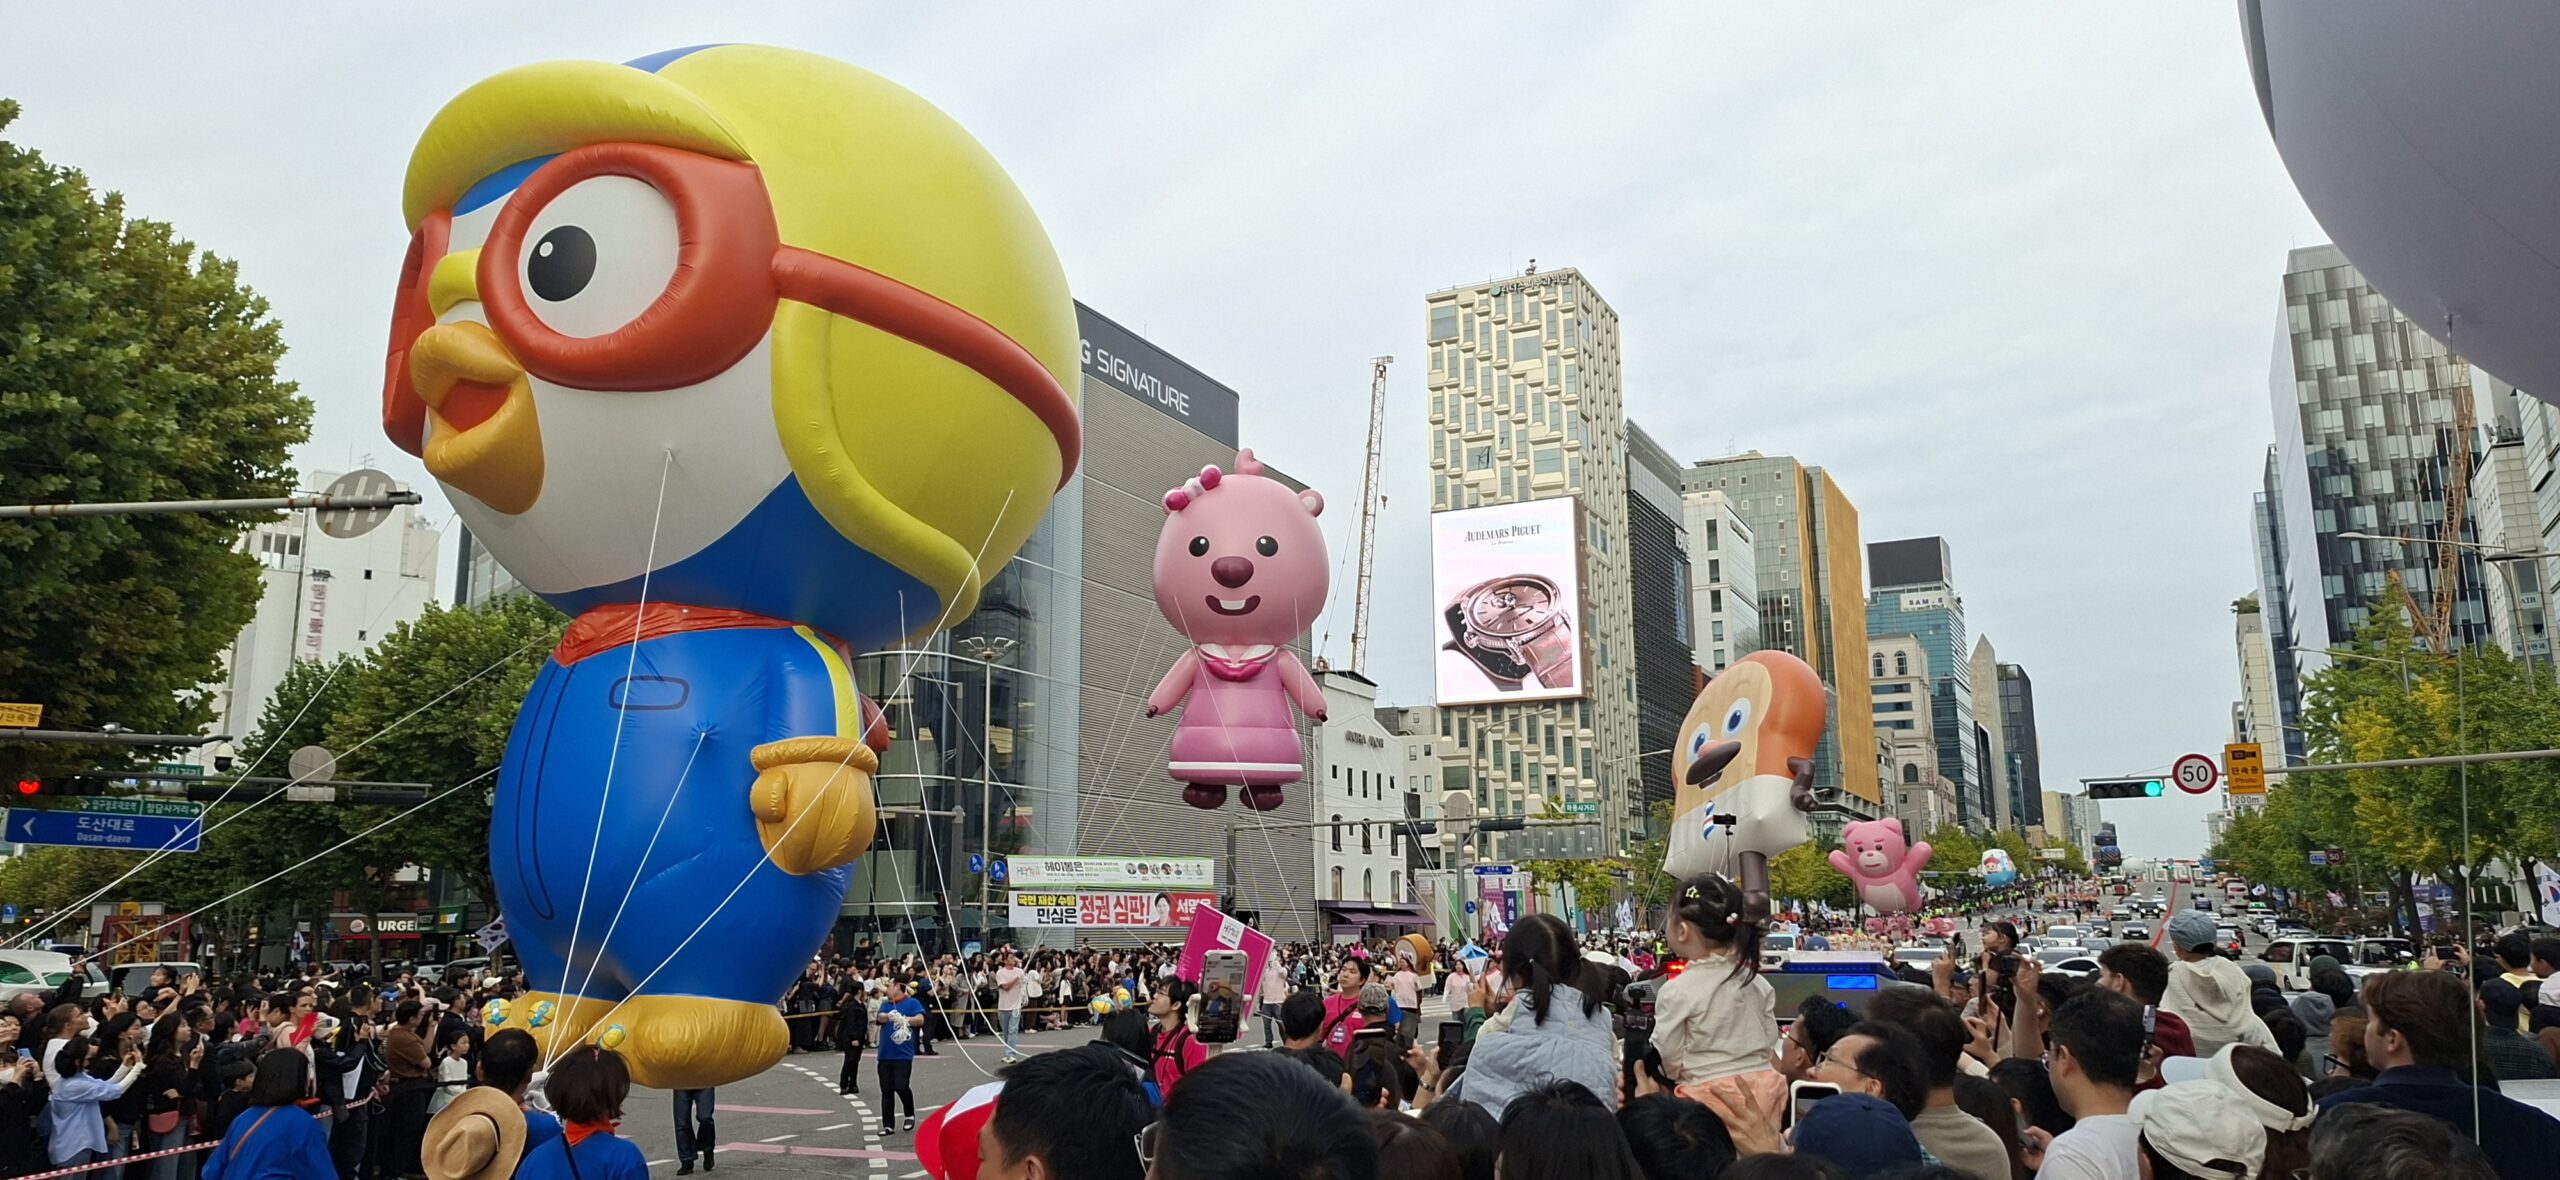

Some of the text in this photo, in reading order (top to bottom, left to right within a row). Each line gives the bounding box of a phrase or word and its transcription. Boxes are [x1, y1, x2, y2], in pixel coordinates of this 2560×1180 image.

[1080, 338, 1190, 417] G SIGNATURE
[1464, 524, 1541, 543] AUDEMARS PIGUET
[2521, 596, 2537, 604] AIR
[2182, 765, 2208, 782] 50
[2235, 796, 2259, 804] 200m
[146, 803, 189, 814] 청담사거리
[76, 816, 135, 832] 도산대로
[76, 832, 132, 844] Dosan-daero
[2329, 852, 2340, 861] 50
[1018, 895, 1036, 906] 국민
[1038, 895, 1056, 906] 재산
[1037, 895, 1151, 925] 민심은 정권 심판!
[377, 920, 416, 931] URGE
